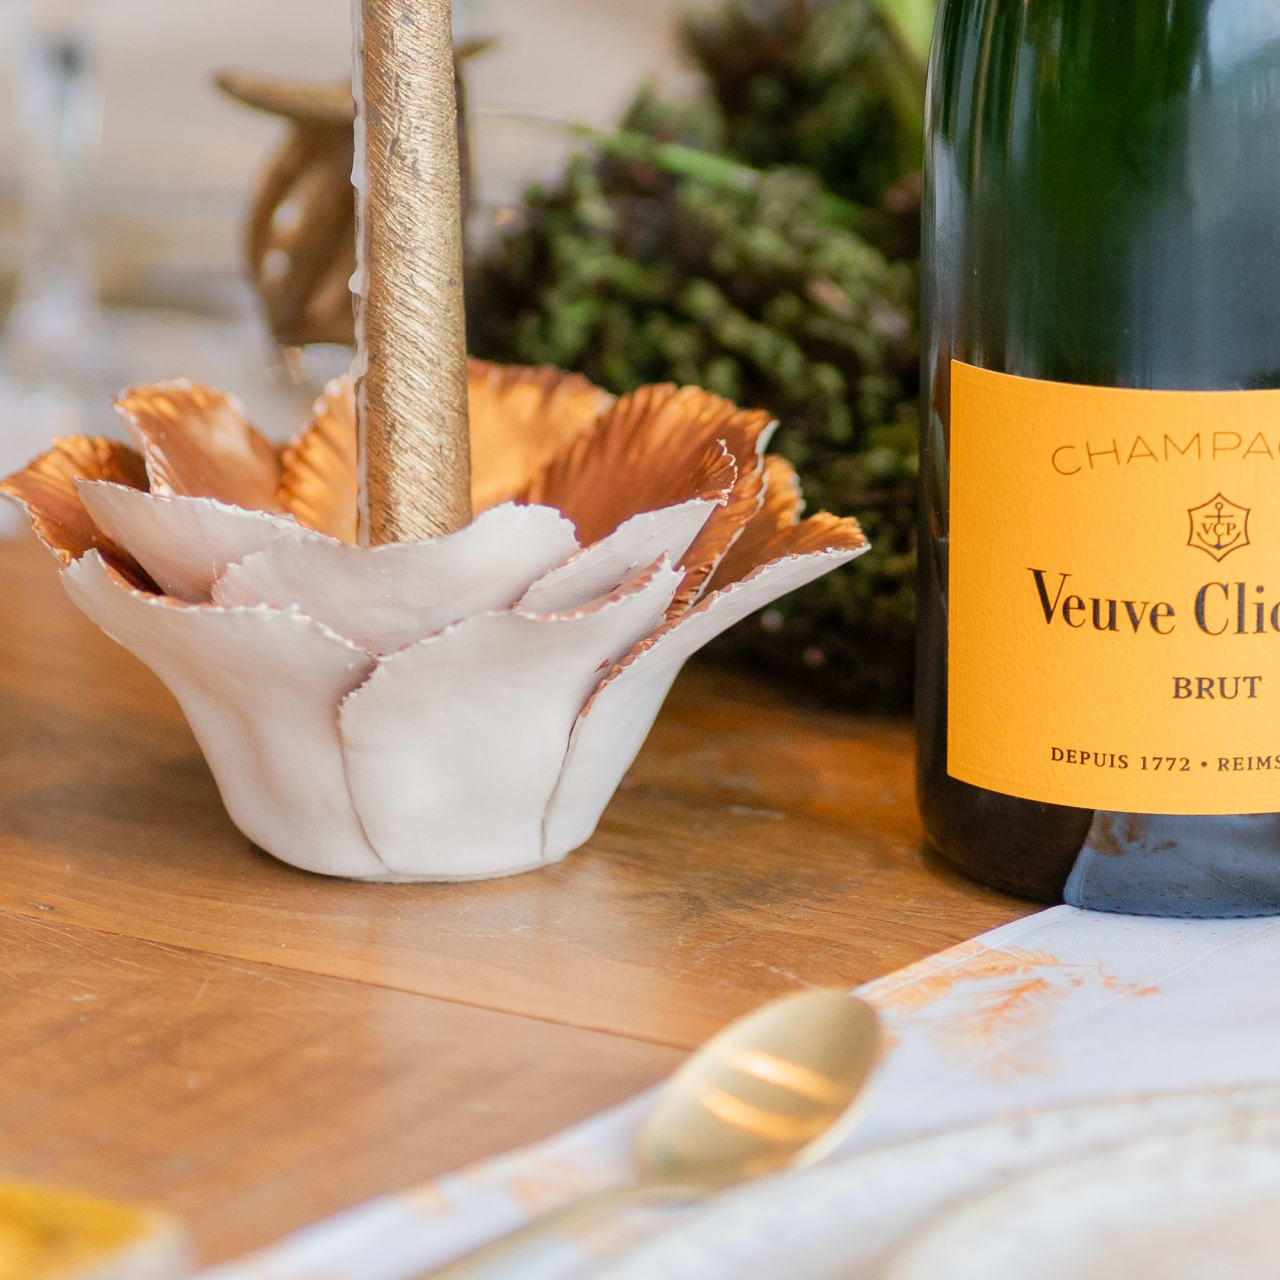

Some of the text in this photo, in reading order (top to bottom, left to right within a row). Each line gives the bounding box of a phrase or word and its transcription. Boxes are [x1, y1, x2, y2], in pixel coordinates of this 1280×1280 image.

[1201, 522, 1237, 537] VCP
[1027, 567, 1176, 635] Veuve
[1172, 676, 1262, 700] BRUT
[1050, 746, 1129, 769] DEPUIS
[1140, 755, 1191, 771] 1772
